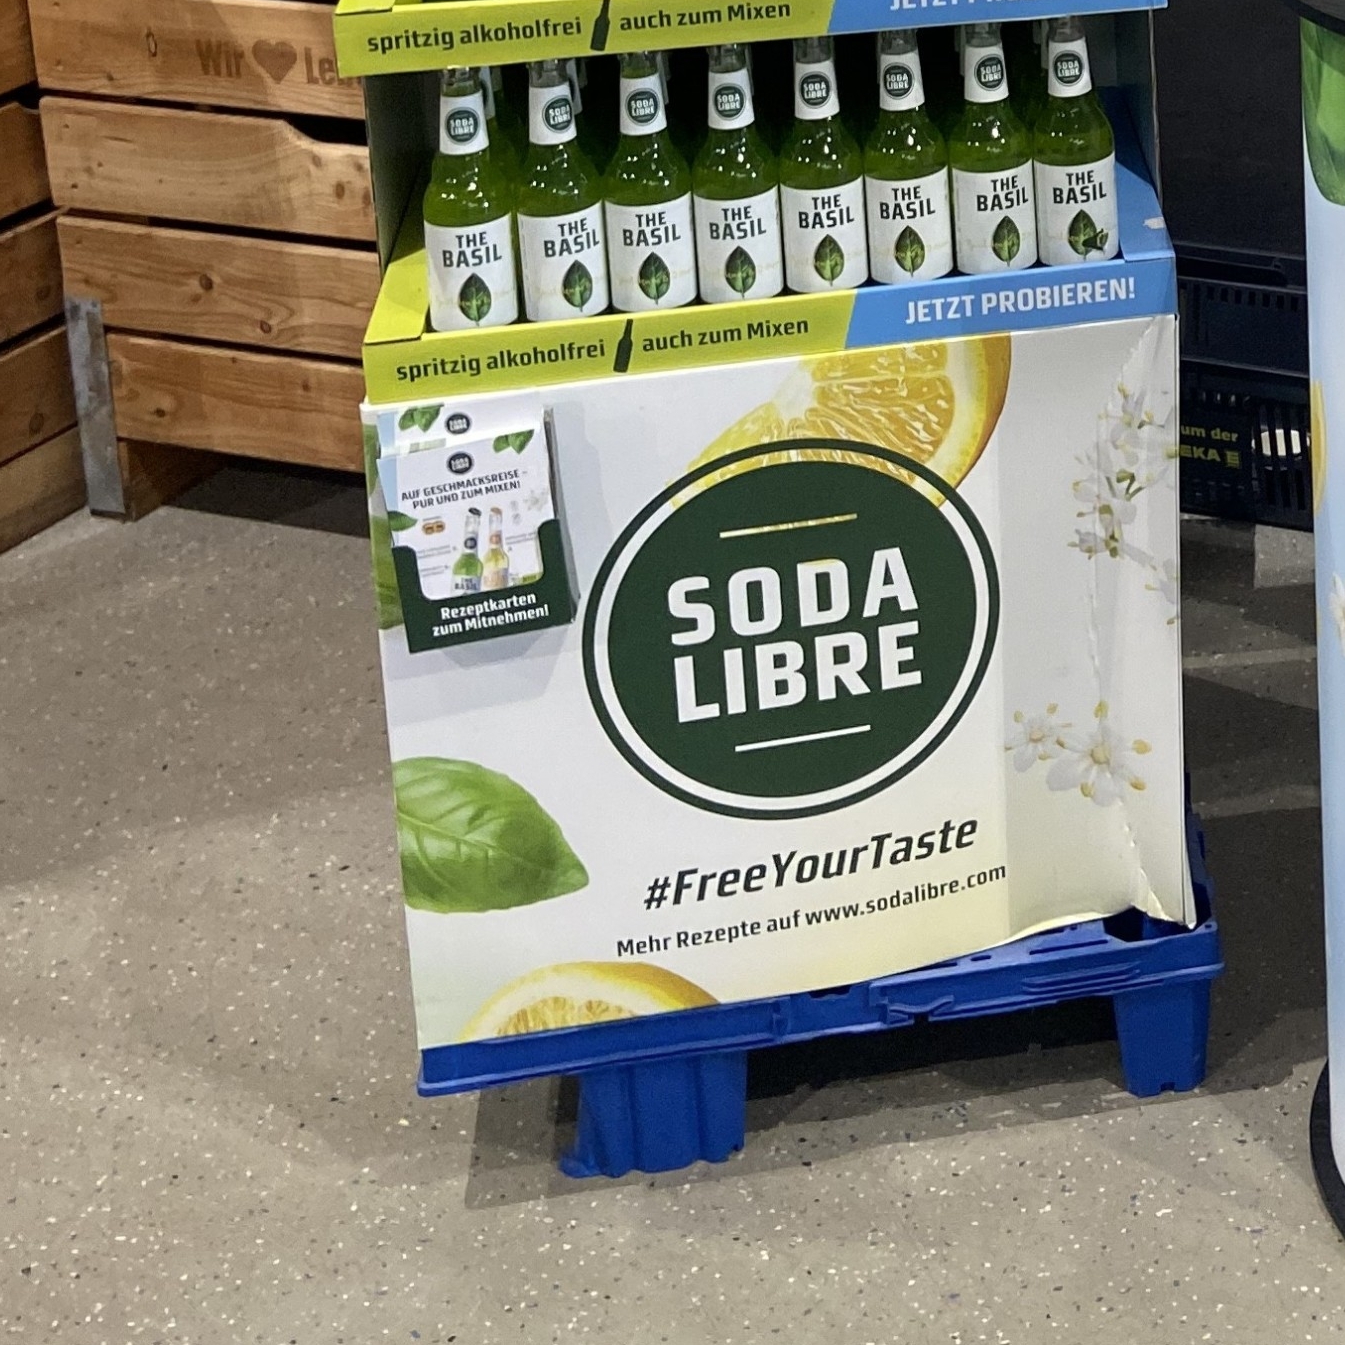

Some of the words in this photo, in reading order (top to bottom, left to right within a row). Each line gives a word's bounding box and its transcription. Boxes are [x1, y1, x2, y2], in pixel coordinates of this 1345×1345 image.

[367, 26, 454, 53] spritzig
[458, 18, 582, 46] alkoholfrei
[619, 9, 672, 32] auch
[676, 7, 722, 27] zum
[727, 0, 791, 22] Mixen
[990, 175, 1018, 191] THE
[1065, 170, 1094, 186] THE
[811, 194, 841, 210] THE
[891, 185, 922, 201] THE
[976, 188, 1029, 212] BASIL
[1052, 184, 1108, 205] BASIL
[634, 211, 667, 228] THE
[721, 206, 752, 222] THE
[798, 207, 855, 230] BASIL
[879, 198, 937, 221] BASIL
[557, 218, 588, 234] THE
[622, 224, 682, 247] BASIL
[708, 219, 767, 241] BASIL
[455, 232, 488, 249] THE
[543, 232, 600, 258] BASIL
[442, 245, 502, 269] BASIL
[396, 358, 481, 382] spritzig
[486, 341, 606, 371] alkoholfrei
[642, 329, 693, 352] auch
[698, 327, 742, 347] zum
[746, 319, 809, 341] Mixen
[905, 296, 976, 325] JETZT
[981, 277, 1135, 314] PROBIEREN!
[401, 489, 421, 502] AUF
[423, 468, 520, 497] GESCHMACKSREISE
[412, 497, 434, 510] PUR
[436, 492, 460, 506] UND
[461, 487, 483, 501] ZUM
[485, 480, 521, 496] MIXEN!
[440, 592, 537, 621] Rezeptkarten
[666, 546, 919, 647] SODA
[432, 622, 463, 638] zum
[464, 604, 549, 631] Mitnehmen!
[672, 620, 923, 724] LIBRE
[643, 817, 979, 910] #FreeYourTaste
[616, 932, 671, 958] Mehr
[675, 919, 762, 953] Rezepte
[765, 908, 801, 934] auf
[804, 863, 1008, 927] www.sodalibre.com
